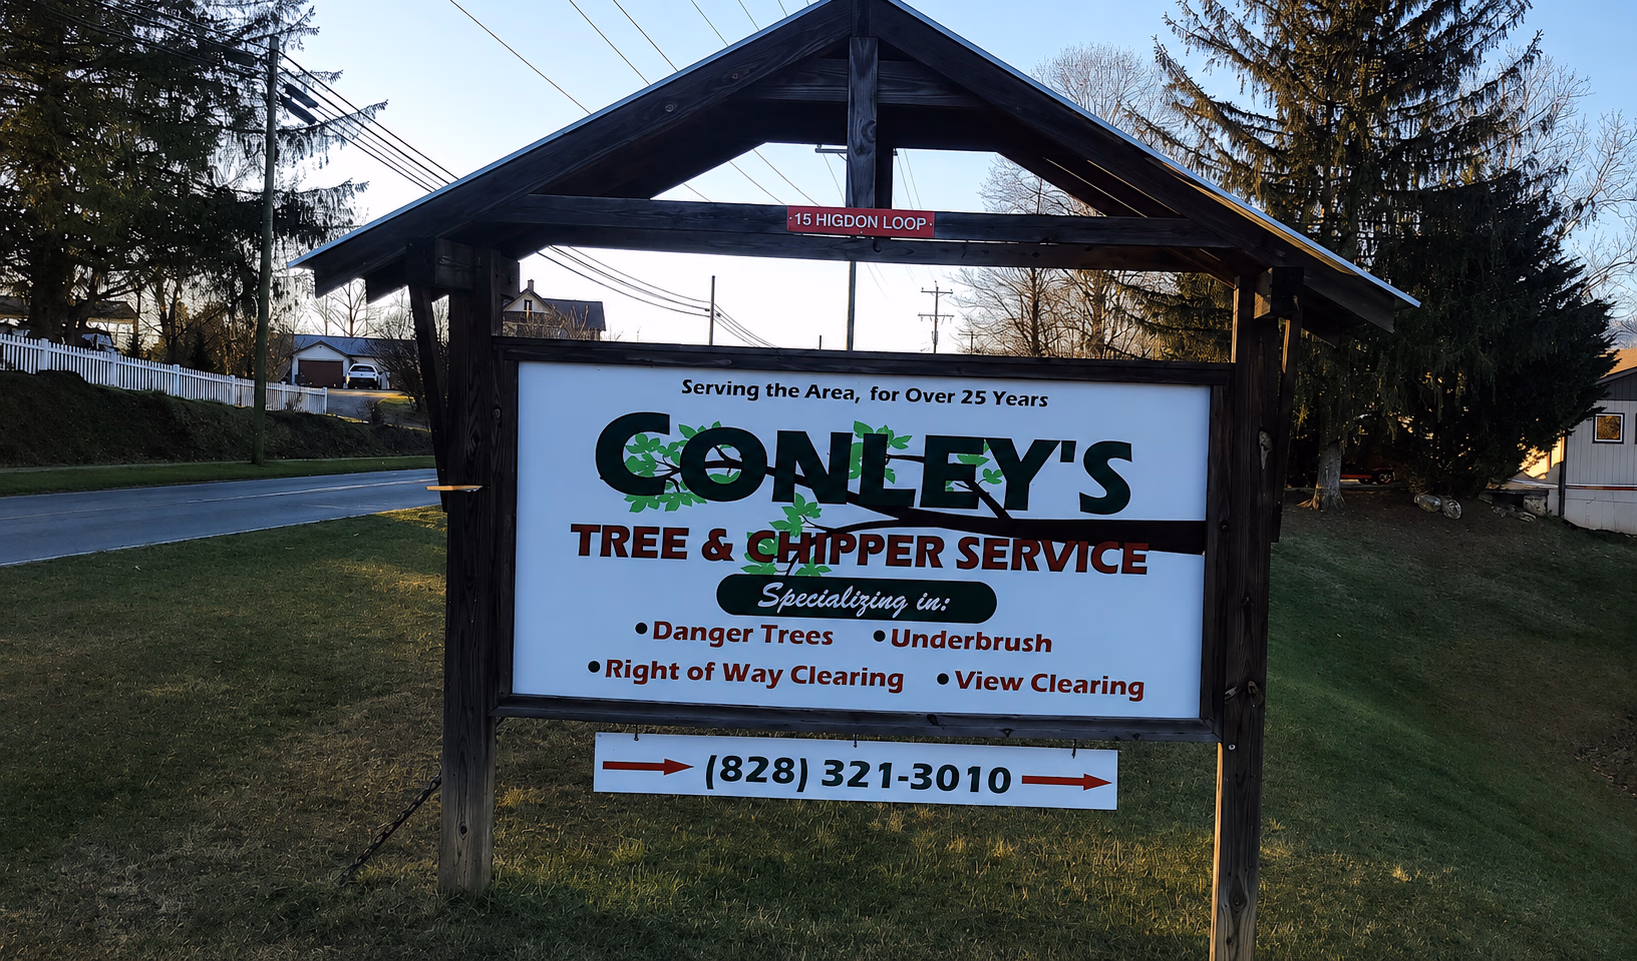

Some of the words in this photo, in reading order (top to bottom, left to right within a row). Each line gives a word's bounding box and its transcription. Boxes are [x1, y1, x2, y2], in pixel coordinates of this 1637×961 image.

[794, 212, 812, 226] 15
[816, 213, 878, 229] HIGDON
[883, 215, 926, 230] LOOP
[681, 378, 759, 401] Serving
[765, 382, 800, 399] the
[804, 383, 861, 404] Area,
[870, 385, 900, 402] for
[904, 387, 956, 405] Over
[960, 388, 987, 405] 25
[991, 390, 1048, 408] Years
[595, 411, 1133, 516] CONLEY'S
[570, 523, 689, 560] TREE
[701, 529, 734, 560] &
[747, 528, 945, 569] CHIPPER
[955, 537, 1149, 575] SERVICE
[757, 581, 909, 619] Specializing
[916, 590, 951, 613] in:
[652, 620, 754, 649] Danger
[760, 624, 834, 646] Trees
[891, 628, 1053, 653] Underbrush
[605, 659, 680, 687] Right
[686, 661, 716, 682] of
[722, 662, 785, 691] Way
[790, 663, 905, 694] Clearing
[955, 670, 1026, 693] View
[1030, 672, 1145, 701] Clearing
[705, 755, 809, 793] (828)
[821, 759, 1012, 795] 321-3010
